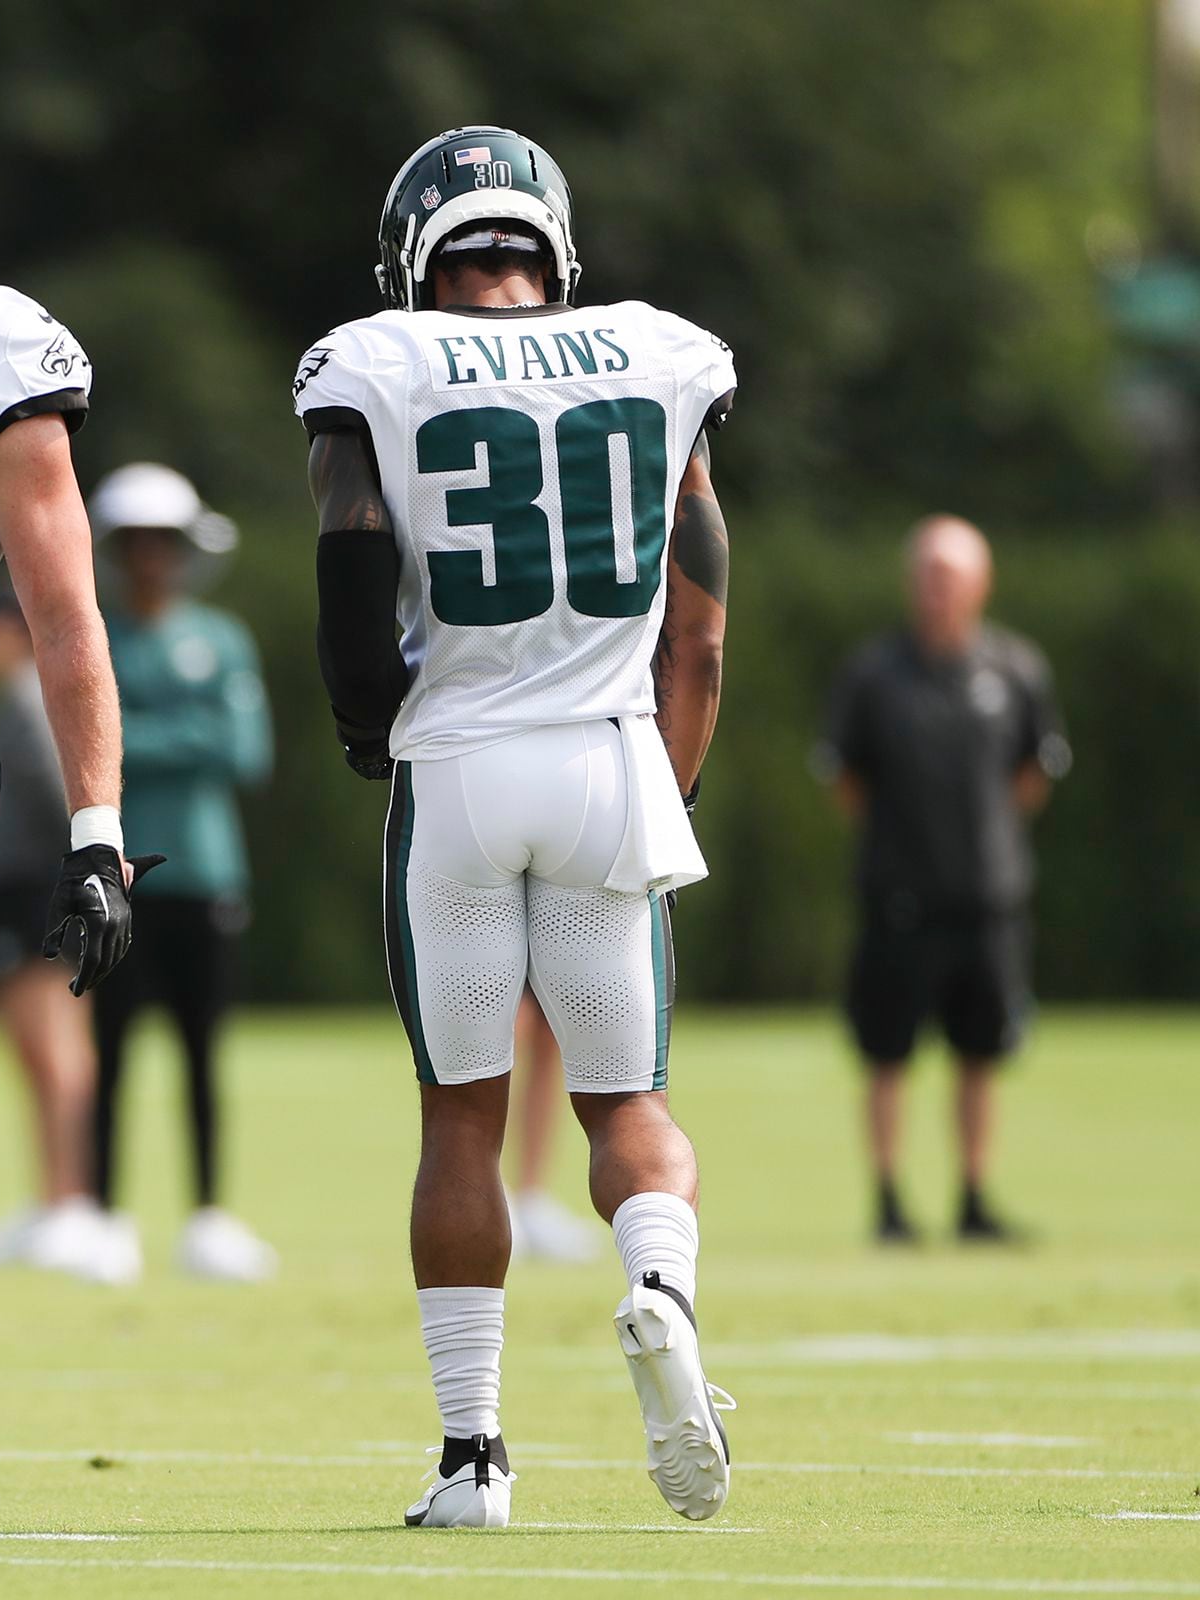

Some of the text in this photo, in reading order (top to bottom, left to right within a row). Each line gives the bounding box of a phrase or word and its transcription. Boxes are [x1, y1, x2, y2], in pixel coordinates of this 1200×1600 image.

[474, 161, 512, 189] 30
[435, 329, 631, 384] EVANS
[416, 397, 667, 627] 30
